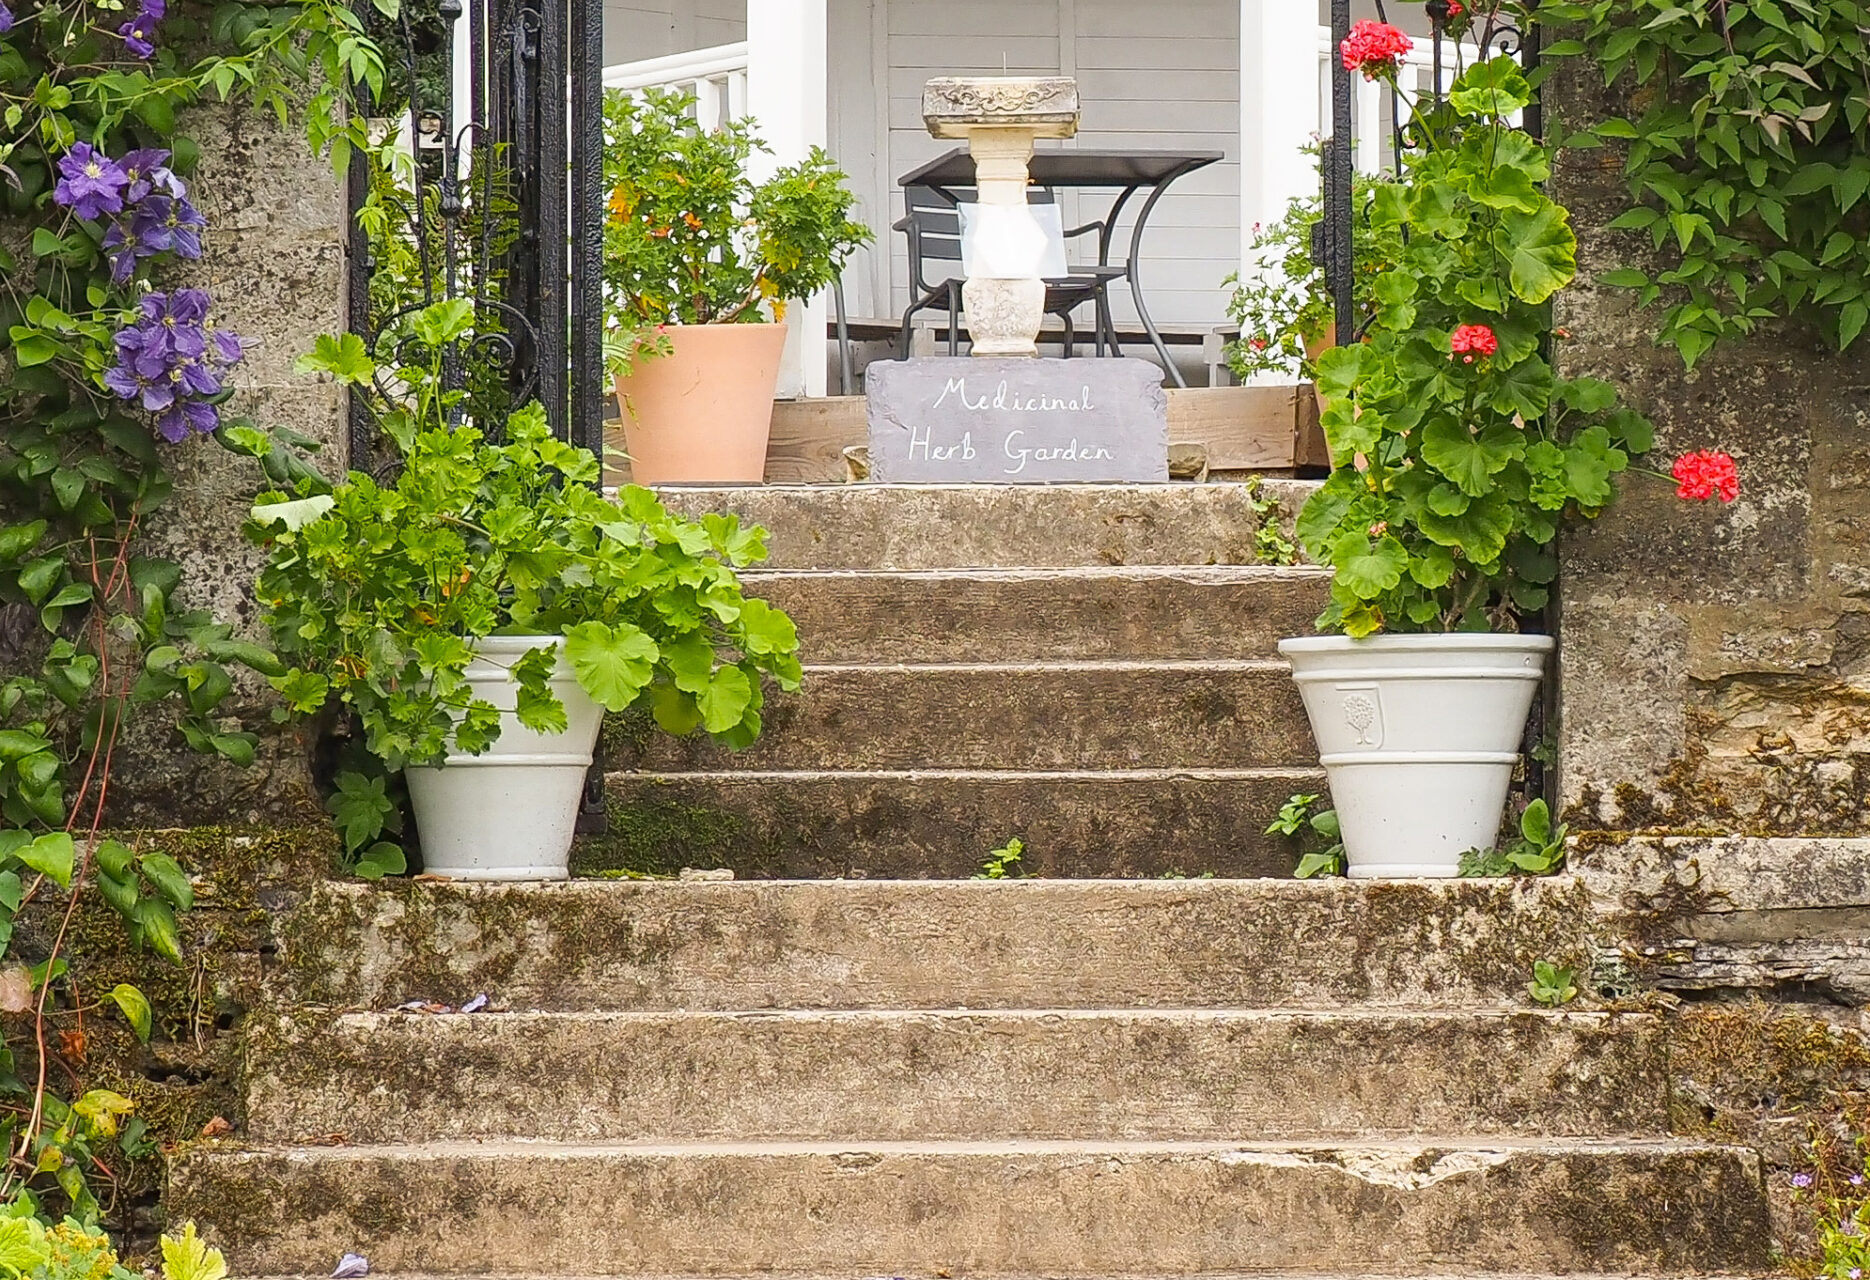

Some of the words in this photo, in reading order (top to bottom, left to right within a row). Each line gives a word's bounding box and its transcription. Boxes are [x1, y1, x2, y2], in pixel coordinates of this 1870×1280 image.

[932, 376, 1095, 411] Medicinal
[907, 425, 976, 461] Herb
[1003, 429, 1114, 474] Garden
